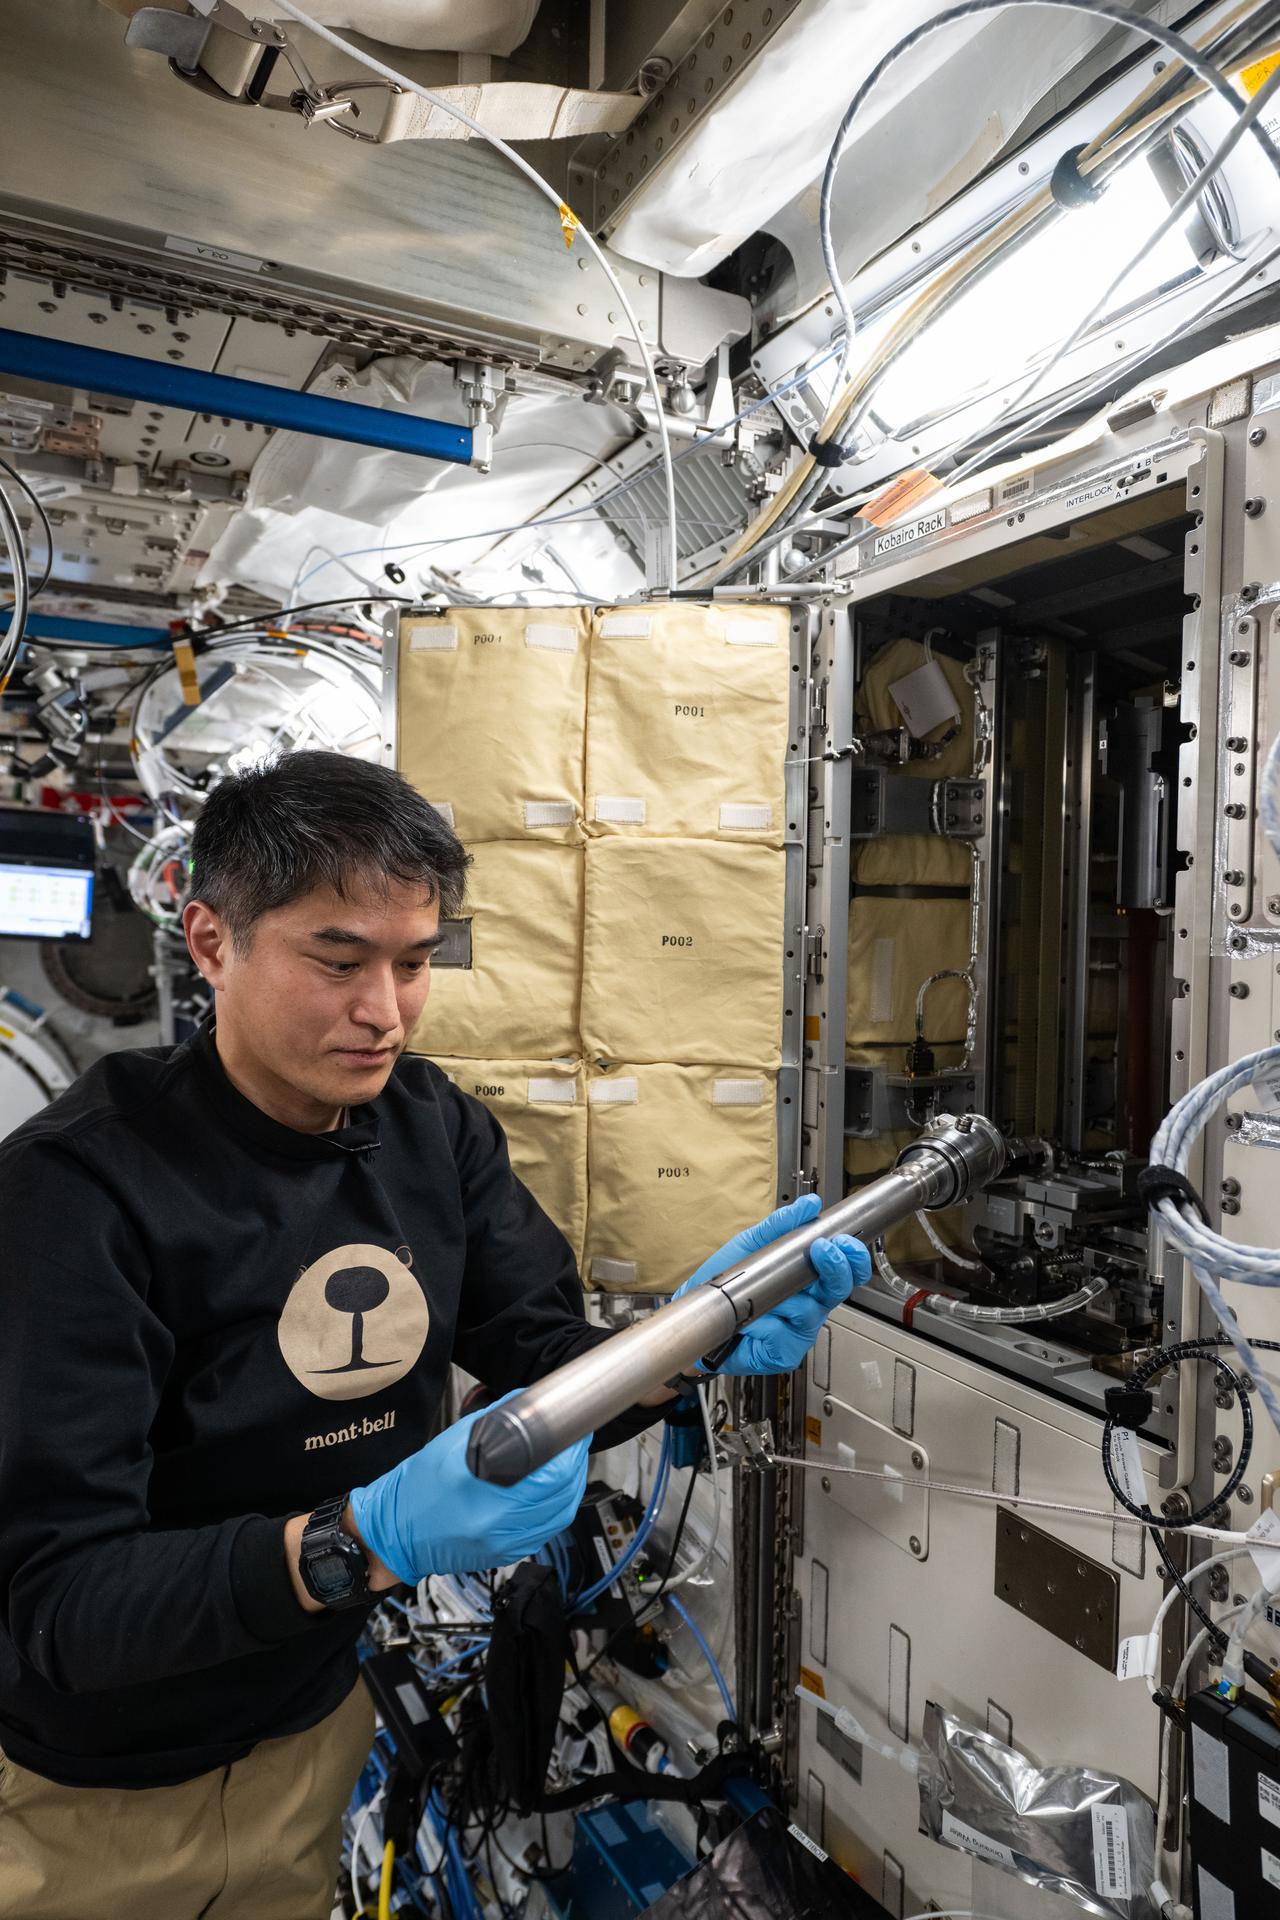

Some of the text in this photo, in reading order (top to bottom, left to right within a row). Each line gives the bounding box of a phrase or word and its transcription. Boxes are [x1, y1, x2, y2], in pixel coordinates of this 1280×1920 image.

[1145, 458, 1152, 466] B
[1066, 484, 1121, 508] INTERLOCK A
[877, 514, 943, 553] Kobairo Rack
[675, 704, 704, 717] P001
[662, 935, 693, 947] P002
[475, 1085, 505, 1097] P006
[658, 1167, 690, 1179] P003
[1121, 1431, 1129, 1441] P1
